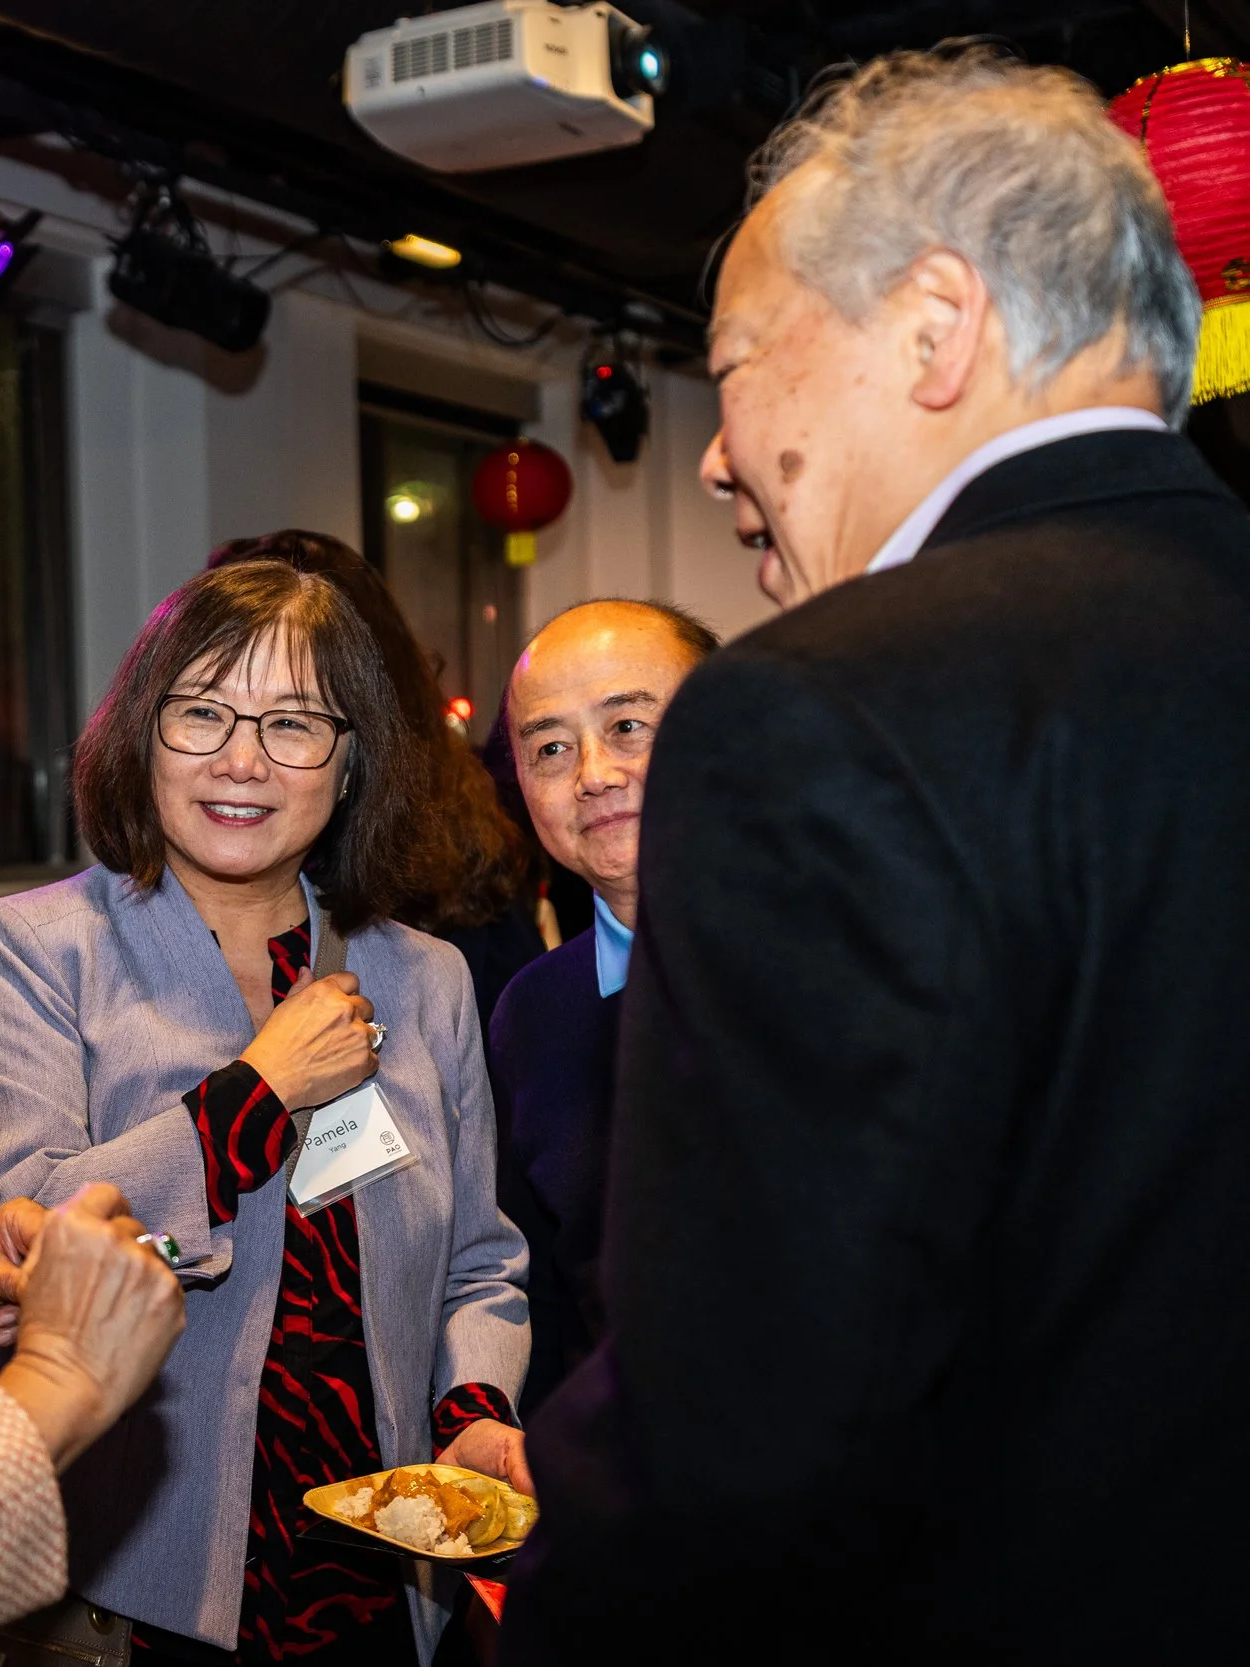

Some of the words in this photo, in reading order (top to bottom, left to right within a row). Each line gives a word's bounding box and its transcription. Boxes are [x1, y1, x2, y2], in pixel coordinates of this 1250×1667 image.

[304, 1119, 358, 1151] Pamela
[329, 1142, 347, 1153] Yang
[385, 1144, 401, 1154] PAO
